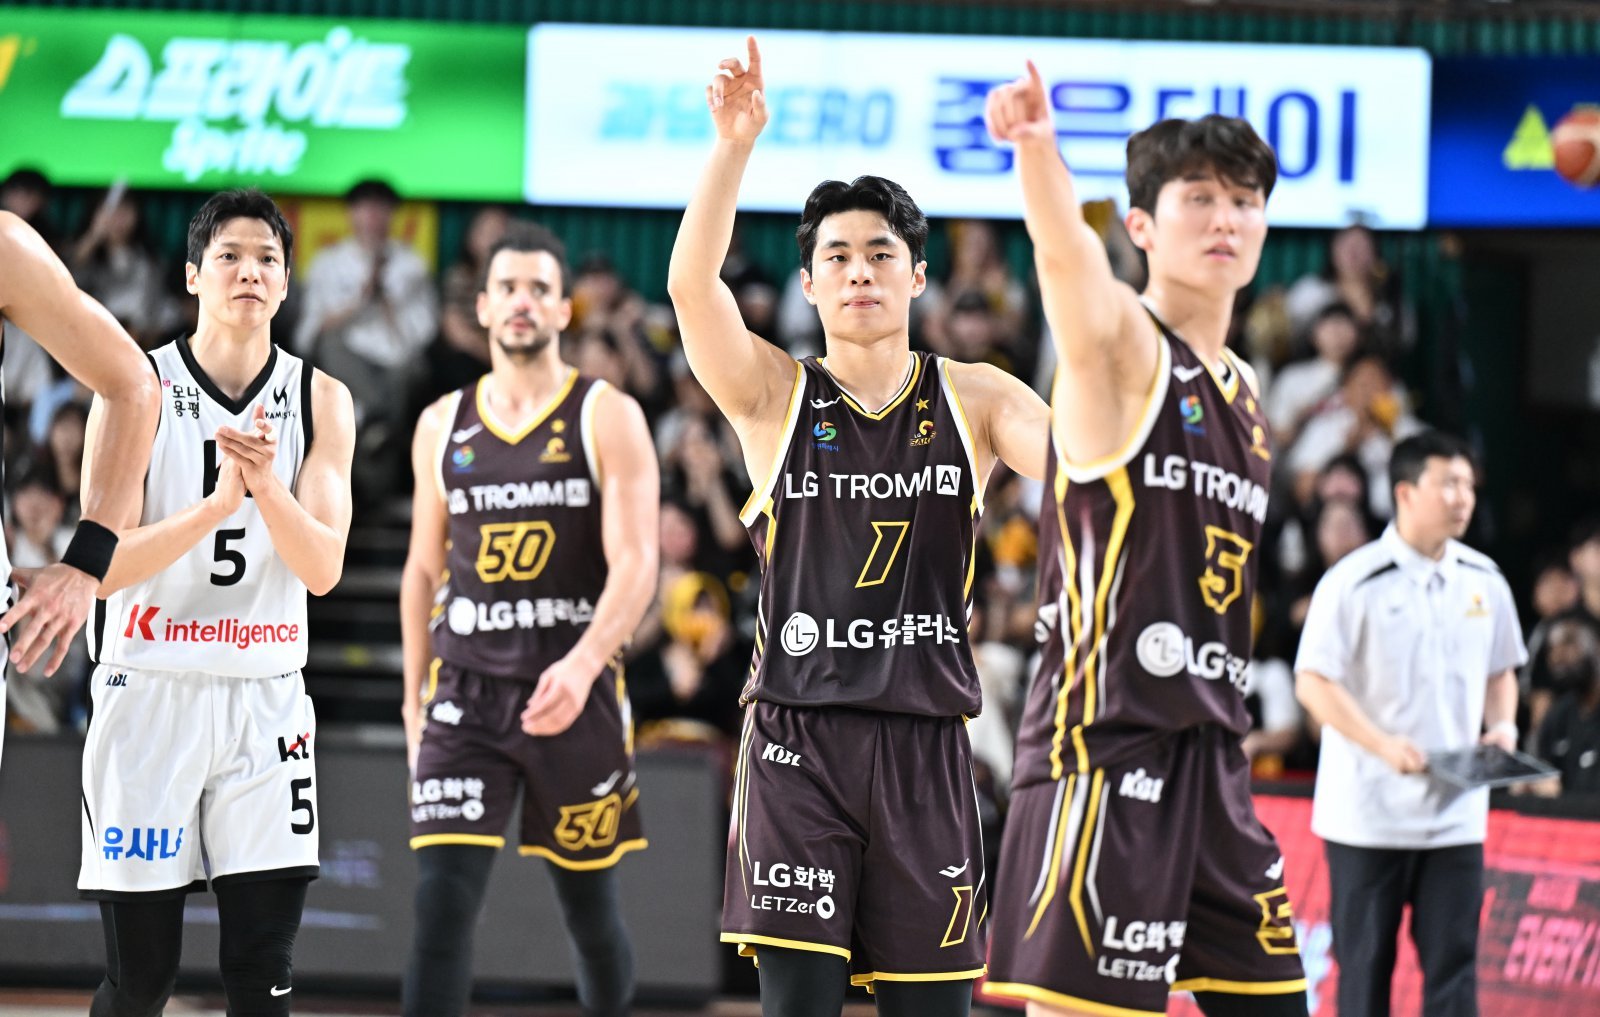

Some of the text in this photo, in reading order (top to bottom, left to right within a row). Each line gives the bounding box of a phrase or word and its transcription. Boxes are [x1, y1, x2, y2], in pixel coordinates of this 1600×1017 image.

[162, 118, 307, 181] Sprite
[786, 471, 819, 499] LG
[828, 466, 932, 499] TROMM
[1144, 453, 1187, 490] LG
[210, 527, 247, 587] 5
[475, 520, 556, 584] 50
[1198, 524, 1253, 615] 5
[124, 604, 299, 650] K intelligence
[761, 742, 801, 767] KBL
[290, 777, 315, 835] 5
[554, 792, 622, 851] 50
